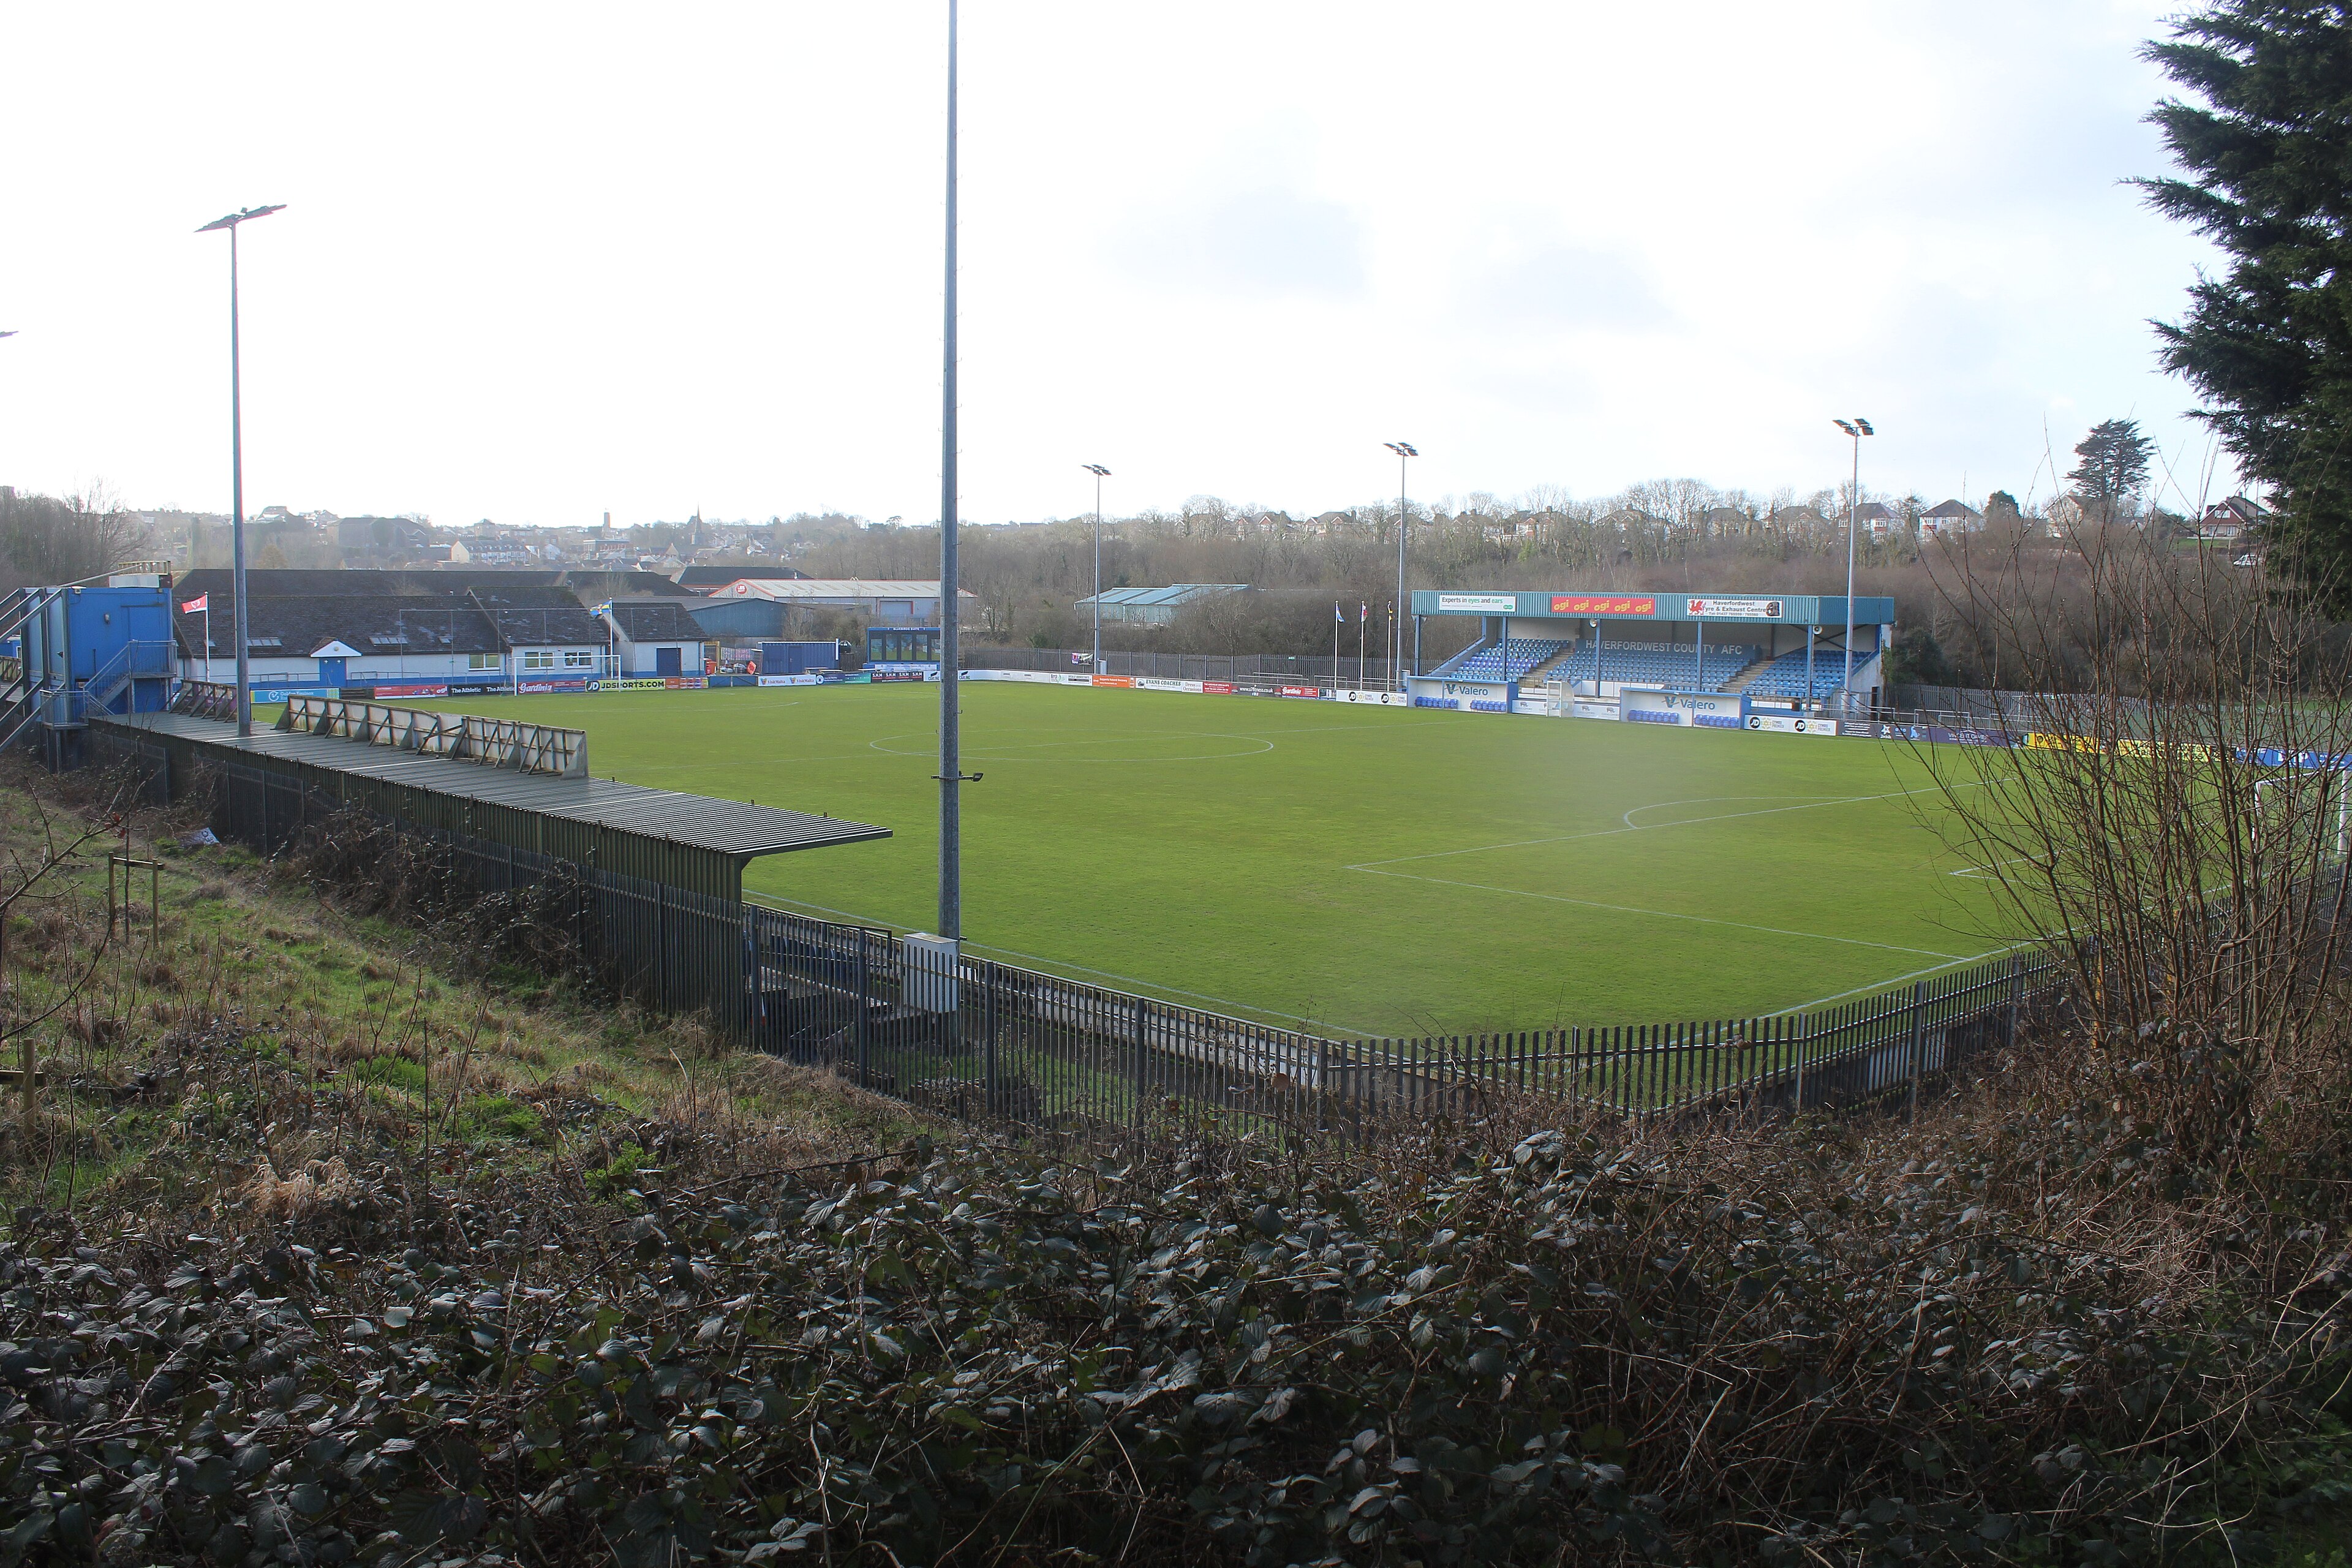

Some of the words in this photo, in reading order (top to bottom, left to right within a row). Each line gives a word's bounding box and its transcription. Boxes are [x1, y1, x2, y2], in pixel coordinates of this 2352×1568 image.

[1554, 600, 1569, 611] ogi
[1574, 600, 1589, 611] ogi
[1594, 600, 1609, 611] ogi
[1615, 601, 1630, 612] ogi
[1635, 601, 1651, 612] ogi
[1721, 645, 1743, 655] AFC
[519, 683, 552, 693] Gardinia
[588, 681, 599, 691] JD
[1282, 686, 1302, 695] Gardinia
[1459, 686, 1488, 696] Valero
[1680, 699, 1715, 710] Valero
